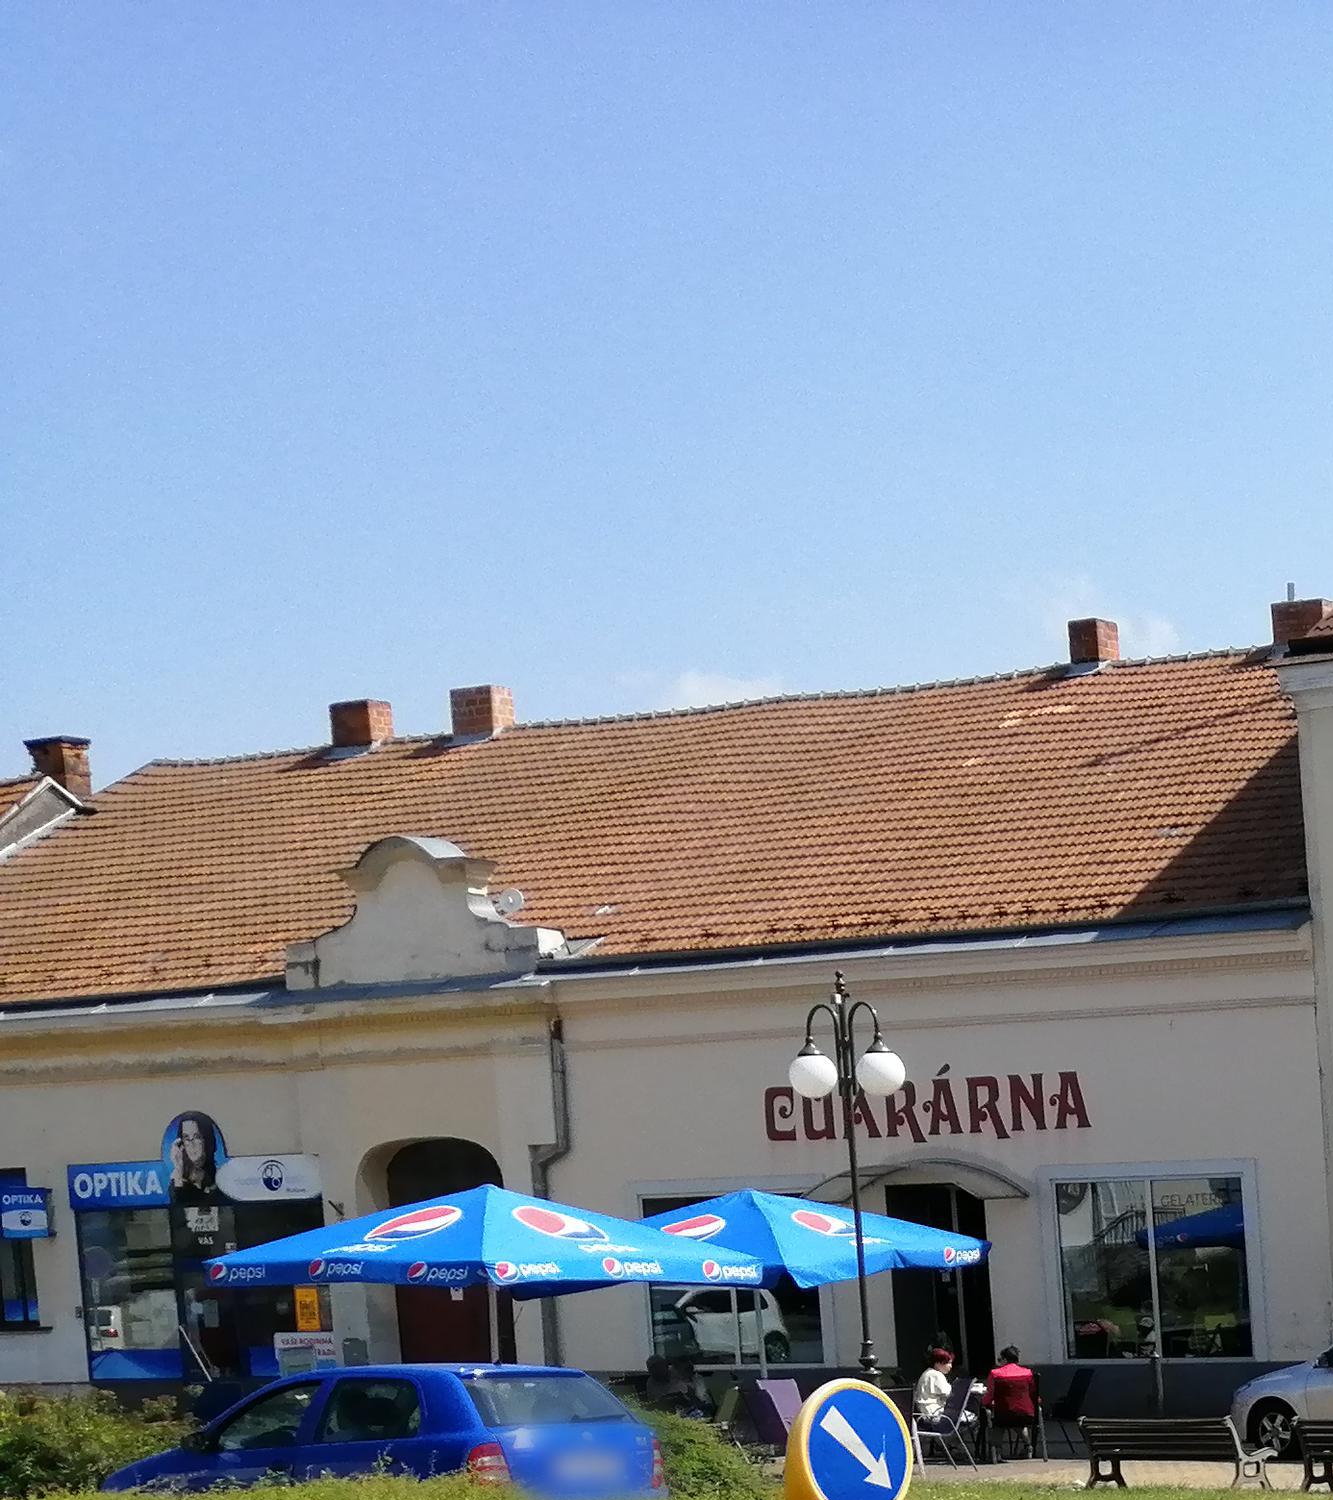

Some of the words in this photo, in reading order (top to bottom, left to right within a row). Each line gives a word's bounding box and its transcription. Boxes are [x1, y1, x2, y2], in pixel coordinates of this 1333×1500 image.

[74, 1169, 163, 1199] OPTIKA
[2, 1194, 44, 1205] OPTIKA
[956, 1248, 980, 1263] pepsi
[228, 1264, 266, 1282] pepsi
[326, 1261, 363, 1277] pepsi
[428, 1265, 469, 1281] pepsi
[519, 1262, 561, 1276] pepsi
[623, 1261, 662, 1276] pepsi
[722, 1264, 757, 1279] pepsi
